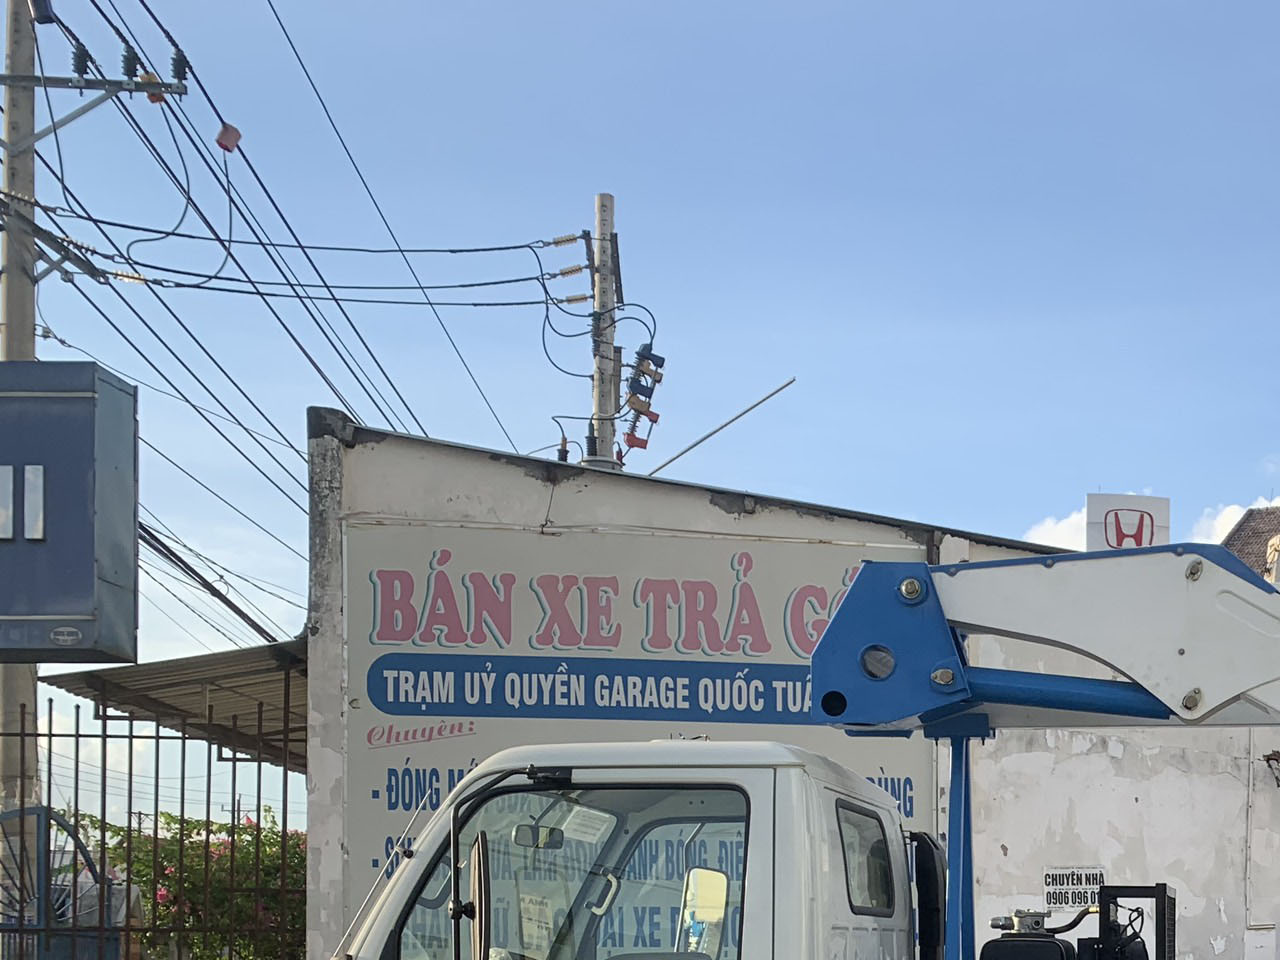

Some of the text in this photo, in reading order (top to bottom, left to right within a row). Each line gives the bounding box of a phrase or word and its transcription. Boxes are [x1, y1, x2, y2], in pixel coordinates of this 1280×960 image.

[369, 548, 517, 649] BÁN
[529, 573, 624, 652] XE
[633, 550, 773, 658] TRẢ
[383, 669, 456, 711] TRẠM
[464, 661, 498, 705] UỶ
[504, 661, 586, 709] QUYỀN
[594, 674, 690, 709] GARAGE
[698, 667, 765, 714] QUỐC
[386, 756, 441, 812] ĐÓNG
[1046, 891, 1070, 906] 0906
[1071, 891, 1089, 906] 096
[1085, 870, 1105, 887] NHÀ
[633, 907, 661, 948] XE
